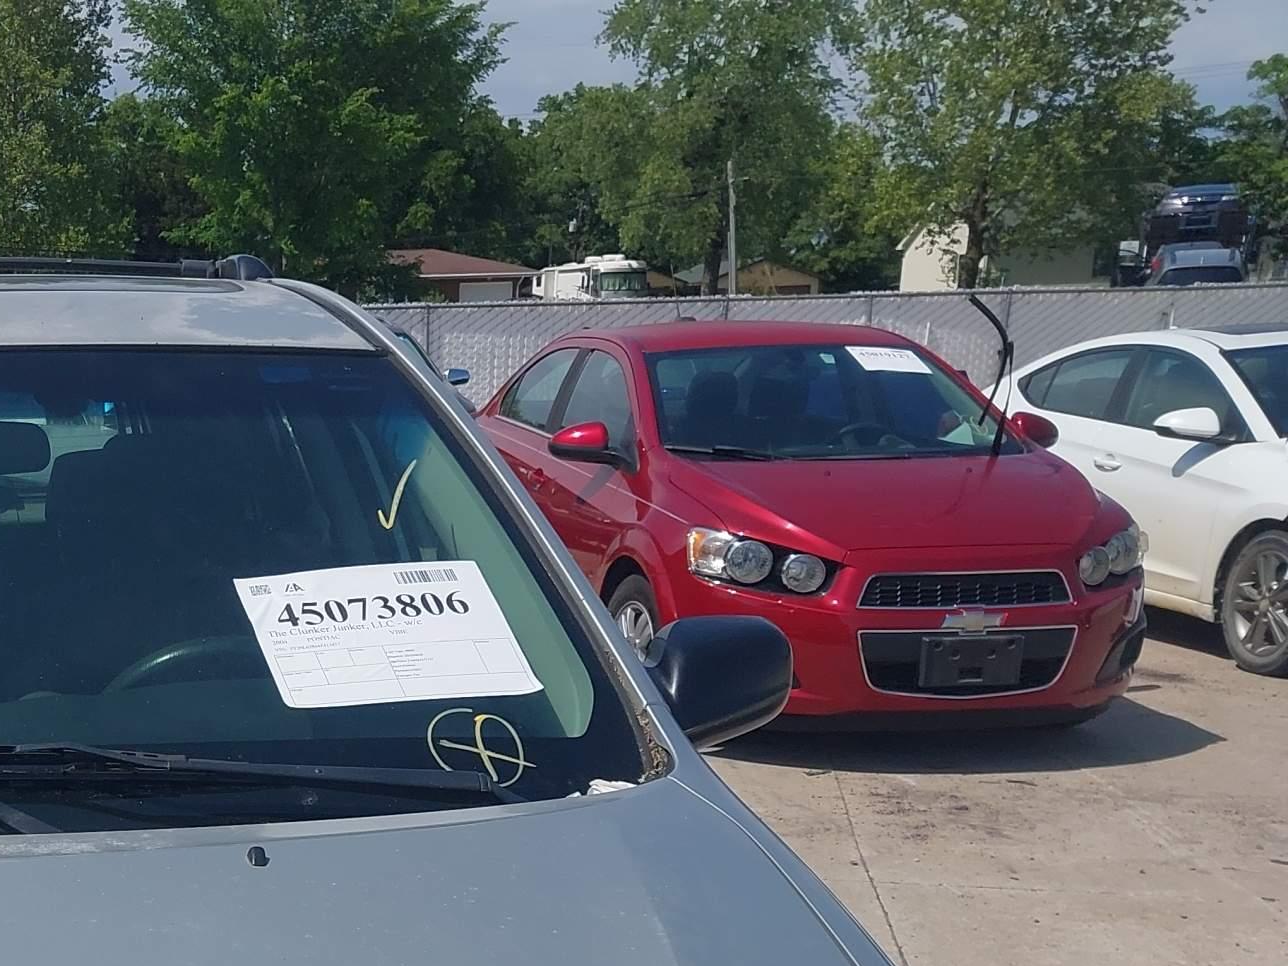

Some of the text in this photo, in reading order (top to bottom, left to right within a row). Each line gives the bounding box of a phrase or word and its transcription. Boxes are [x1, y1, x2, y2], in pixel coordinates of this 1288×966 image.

[278, 591, 469, 626] 45073806
[269, 630, 287, 638] The
[290, 626, 329, 636] Clunker
[332, 623, 369, 633] Junker,
[371, 620, 394, 629] LLC
